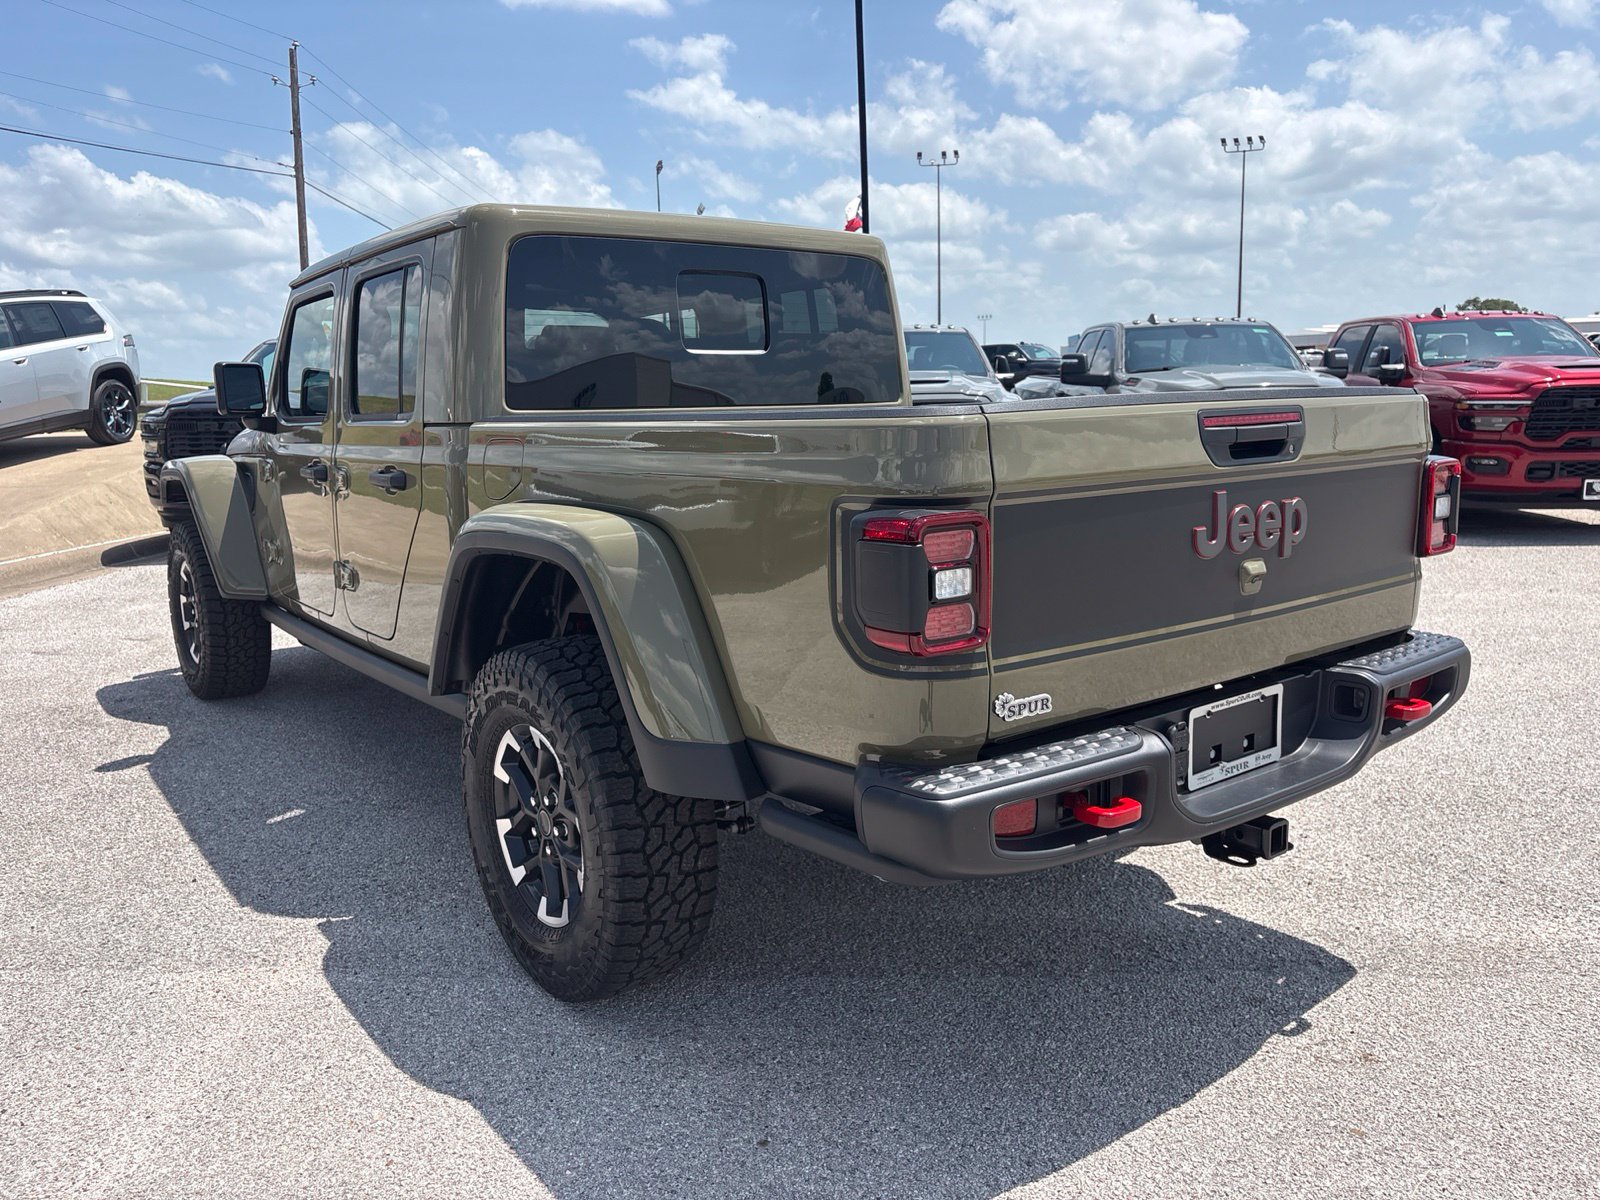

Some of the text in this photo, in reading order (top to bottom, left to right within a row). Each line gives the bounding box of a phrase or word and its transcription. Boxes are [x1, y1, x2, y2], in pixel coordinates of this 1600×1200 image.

[1193, 490, 1308, 559] Jeep
[1007, 698, 1050, 718] SPUR
[1210, 691, 1262, 710] www.SpurCDJR.com
[1224, 760, 1250, 776] SPUR
